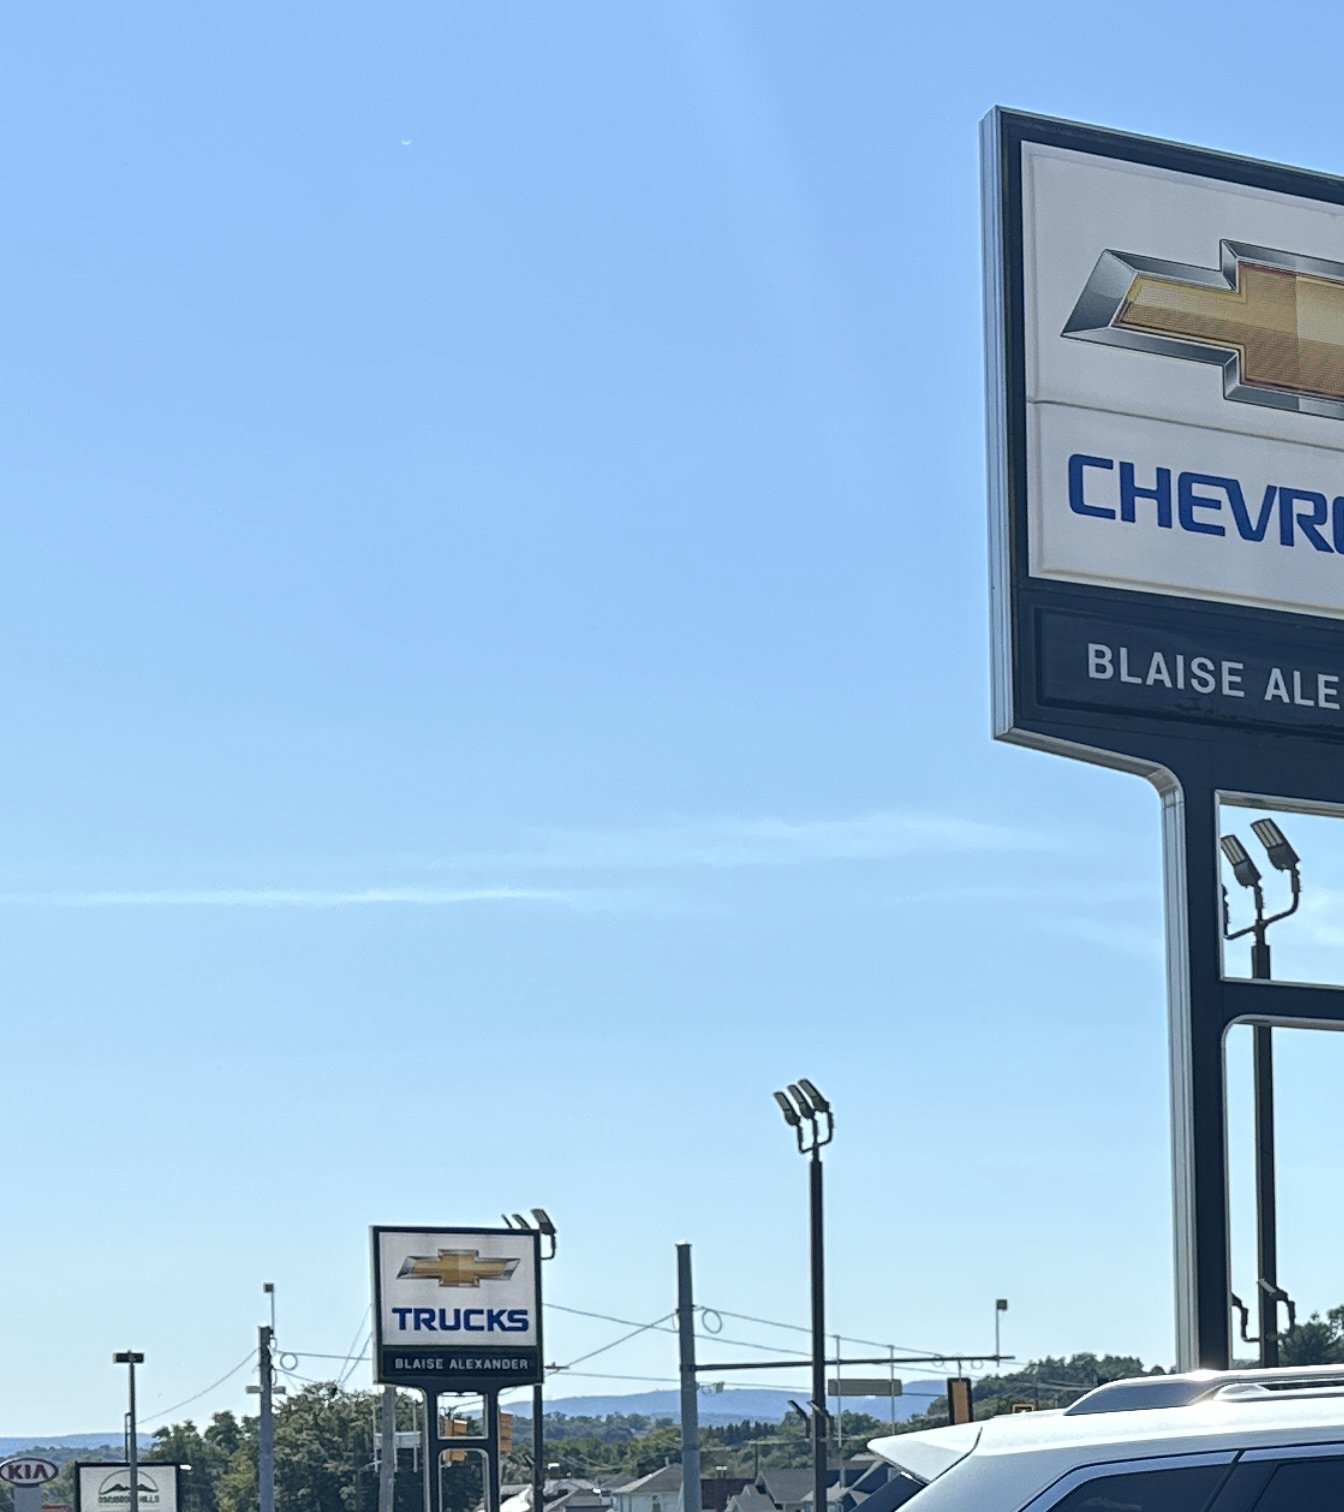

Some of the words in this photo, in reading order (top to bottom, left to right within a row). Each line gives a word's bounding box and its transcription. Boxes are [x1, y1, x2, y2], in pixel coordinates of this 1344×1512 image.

[1087, 642, 1246, 698] BLAISE
[391, 1307, 529, 1332] TRUCKS
[394, 1358, 444, 1370] BLAISE
[449, 1358, 528, 1370] ALEXANDER
[7, 1463, 49, 1480] KIA
